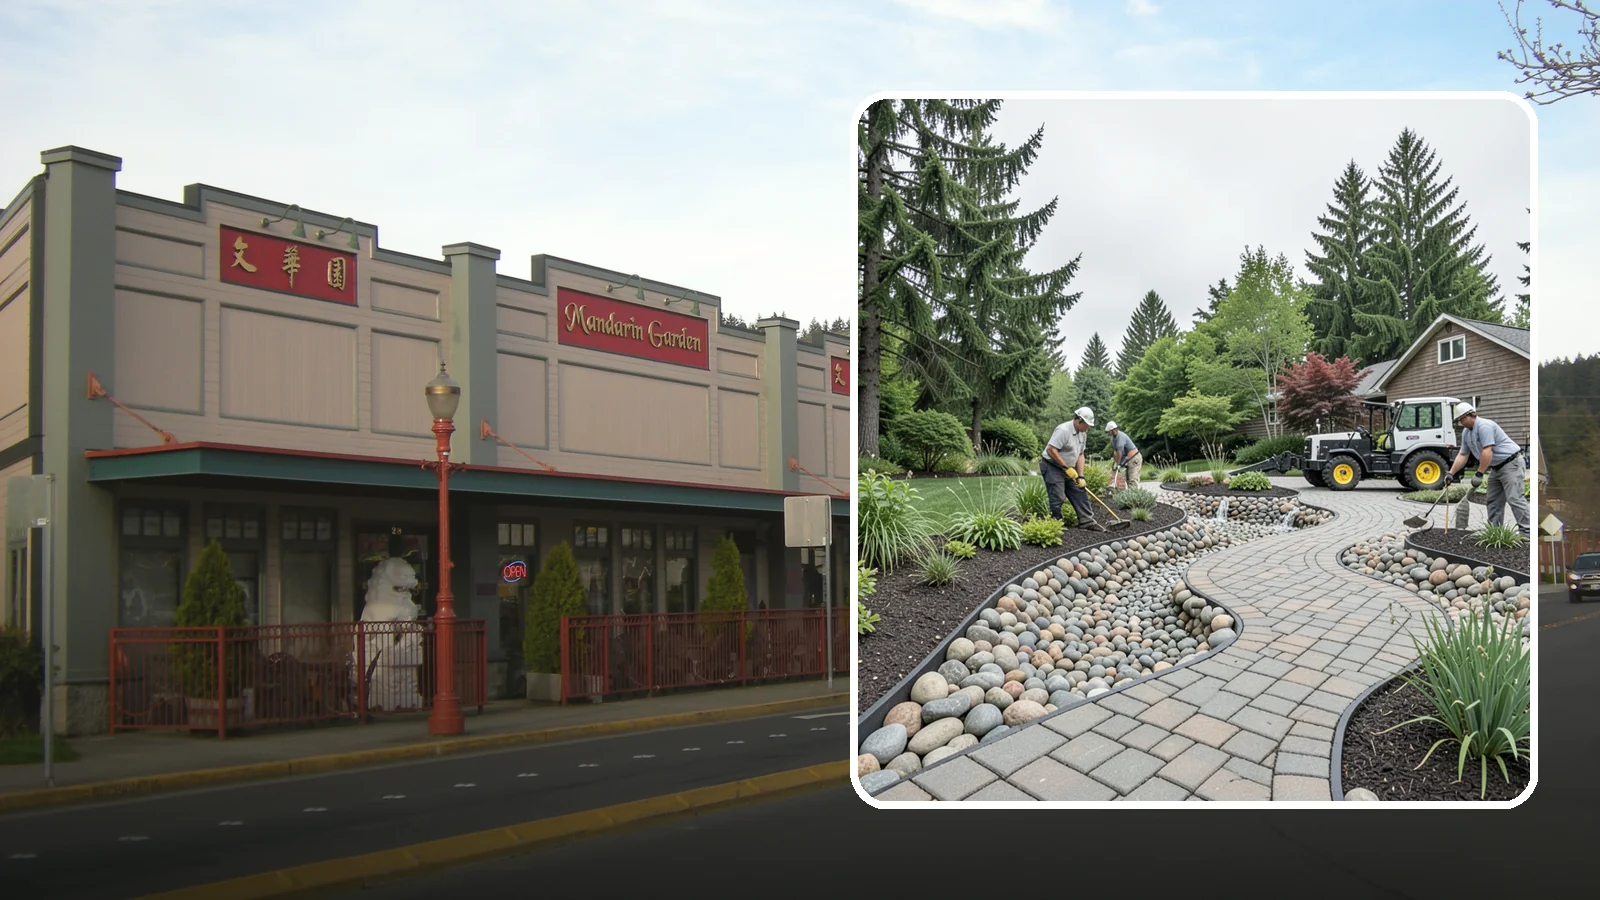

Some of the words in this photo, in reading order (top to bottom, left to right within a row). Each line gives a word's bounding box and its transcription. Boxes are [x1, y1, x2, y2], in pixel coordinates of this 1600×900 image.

[565, 302, 644, 341] Mandarin
[648, 320, 702, 352] Garden
[503, 565, 527, 578] OPEN
